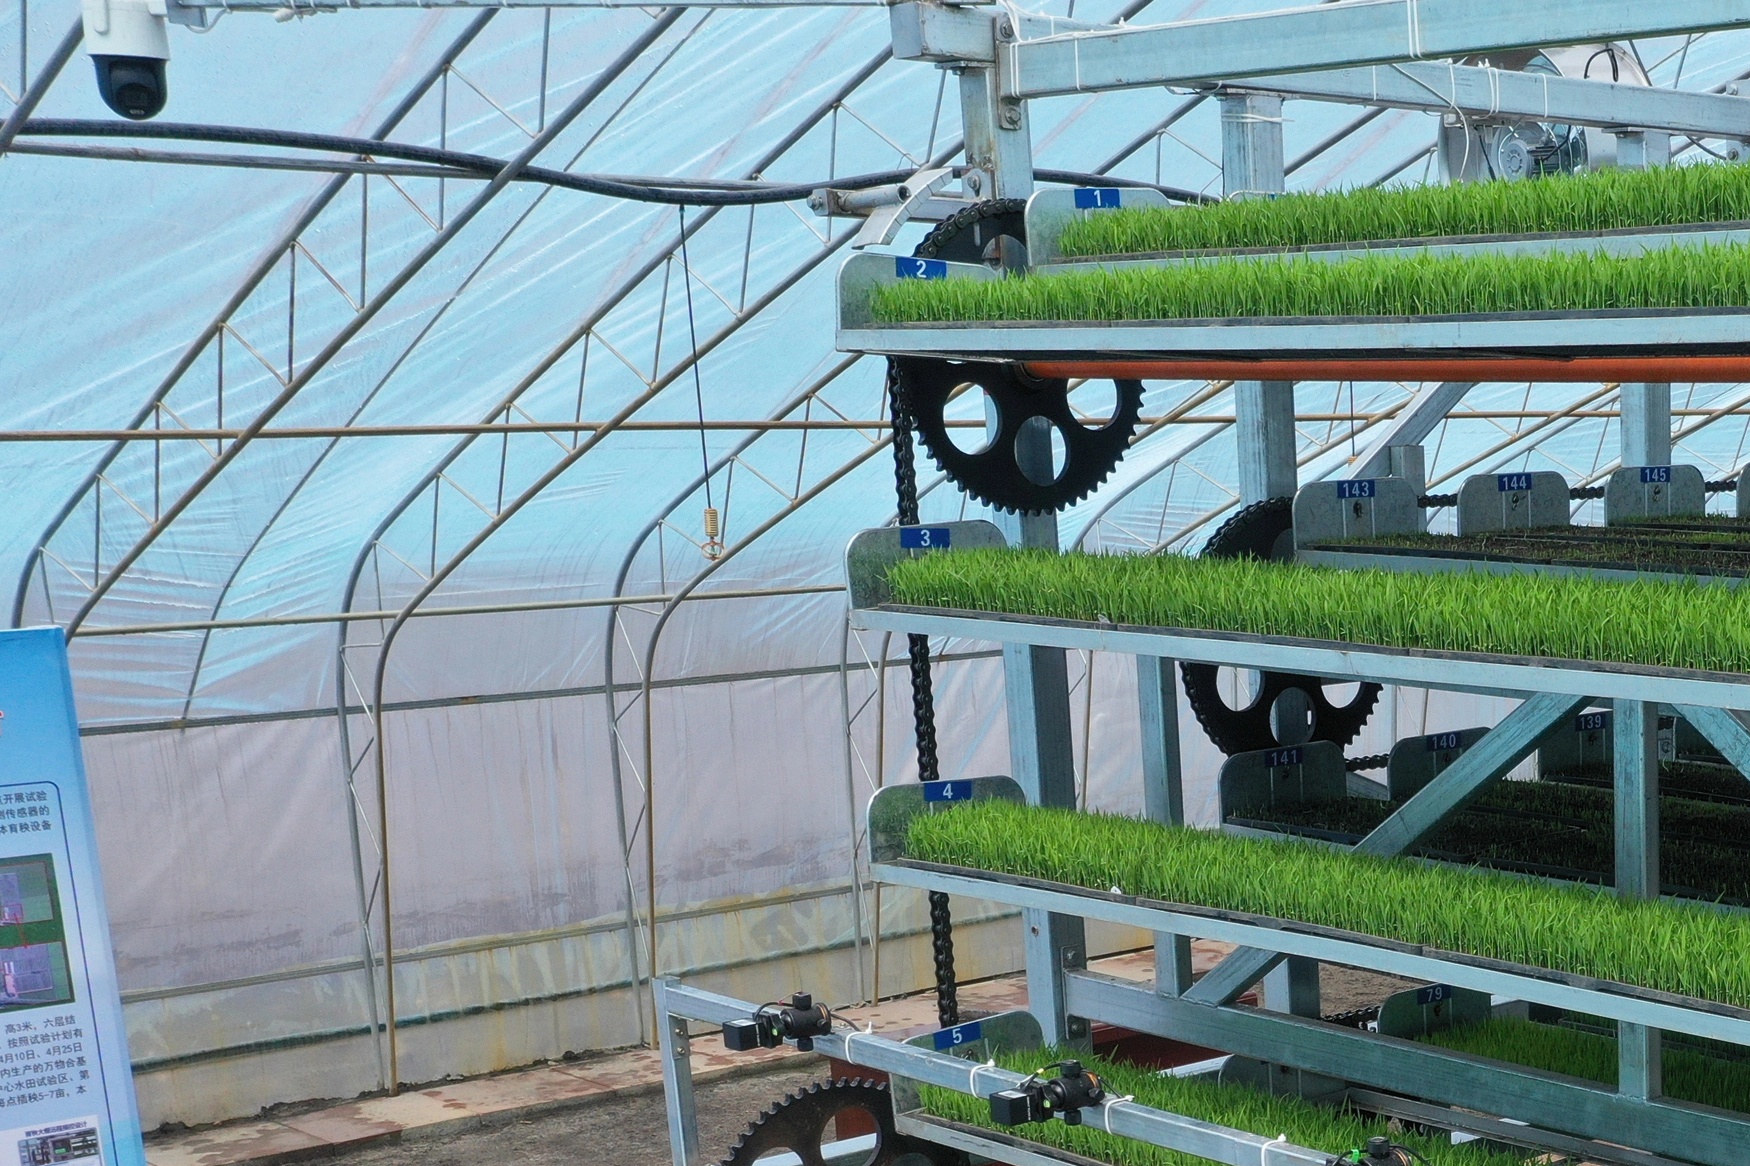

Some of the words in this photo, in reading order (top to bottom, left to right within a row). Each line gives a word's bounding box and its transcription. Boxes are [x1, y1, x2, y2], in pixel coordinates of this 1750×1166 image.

[1093, 189, 1101, 207] 1
[916, 260, 927, 278] 2
[1502, 475, 1527, 490] 144
[1645, 467, 1667, 482] 145
[1342, 482, 1370, 498] 143
[920, 529, 931, 547] 3
[1579, 715, 1603, 730] 139
[1432, 733, 1458, 749] 140
[1271, 749, 1300, 766] 141
[0, 791, 47, 804] 开展试验
[942, 783, 953, 799] 4
[1426, 985, 1444, 1002] 79
[952, 1028, 963, 1044] 5
[0, 1070, 89, 1092] 心水田试验区、第
